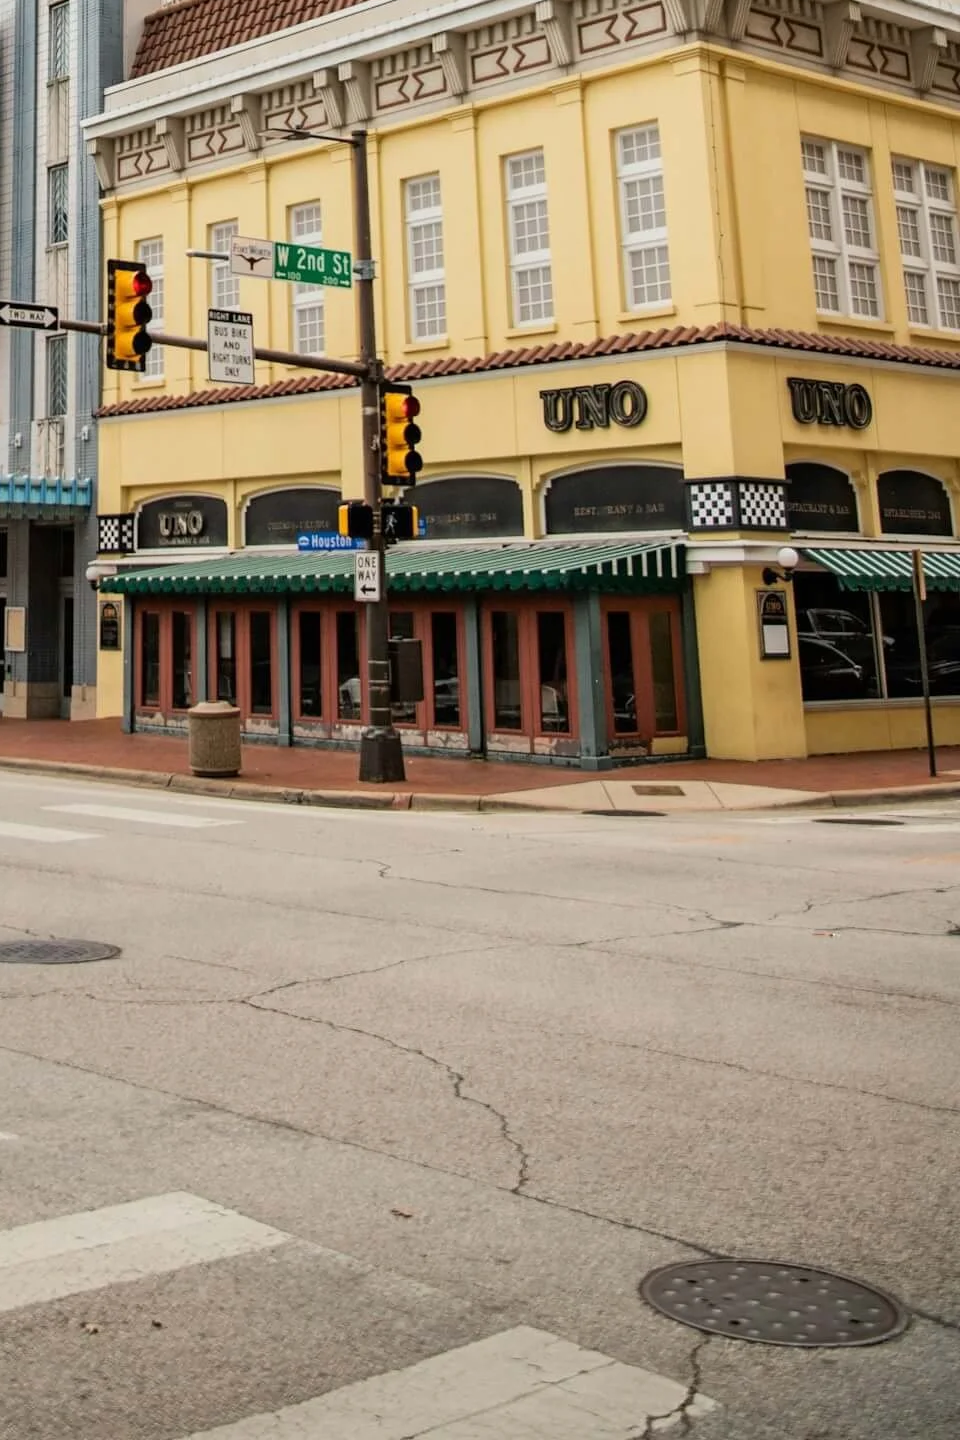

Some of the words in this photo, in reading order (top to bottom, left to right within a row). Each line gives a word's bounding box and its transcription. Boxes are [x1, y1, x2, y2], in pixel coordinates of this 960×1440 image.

[277, 245, 289, 267] W
[297, 248, 325, 272] 2nd
[332, 254, 350, 275] St
[287, 271, 301, 280] 100
[322, 276, 339, 285] 200
[9, 310, 25, 319] TWO
[30, 312, 45, 321] WAY
[210, 311, 230, 321] RIGHT
[232, 314, 251, 323] LANE
[214, 326, 228, 336] BUS
[232, 327, 248, 339] BIKE
[224, 341, 240, 350] AND
[212, 352, 230, 362] RIGHT
[232, 354, 251, 365] TURNS
[225, 366, 240, 376] ONLY
[539, 380, 648, 433] UNO
[787, 376, 873, 431] UNO
[158, 510, 203, 536] UNO
[311, 534, 353, 548] Houston
[357, 556, 377, 568] ONE
[358, 569, 377, 580] WAY
